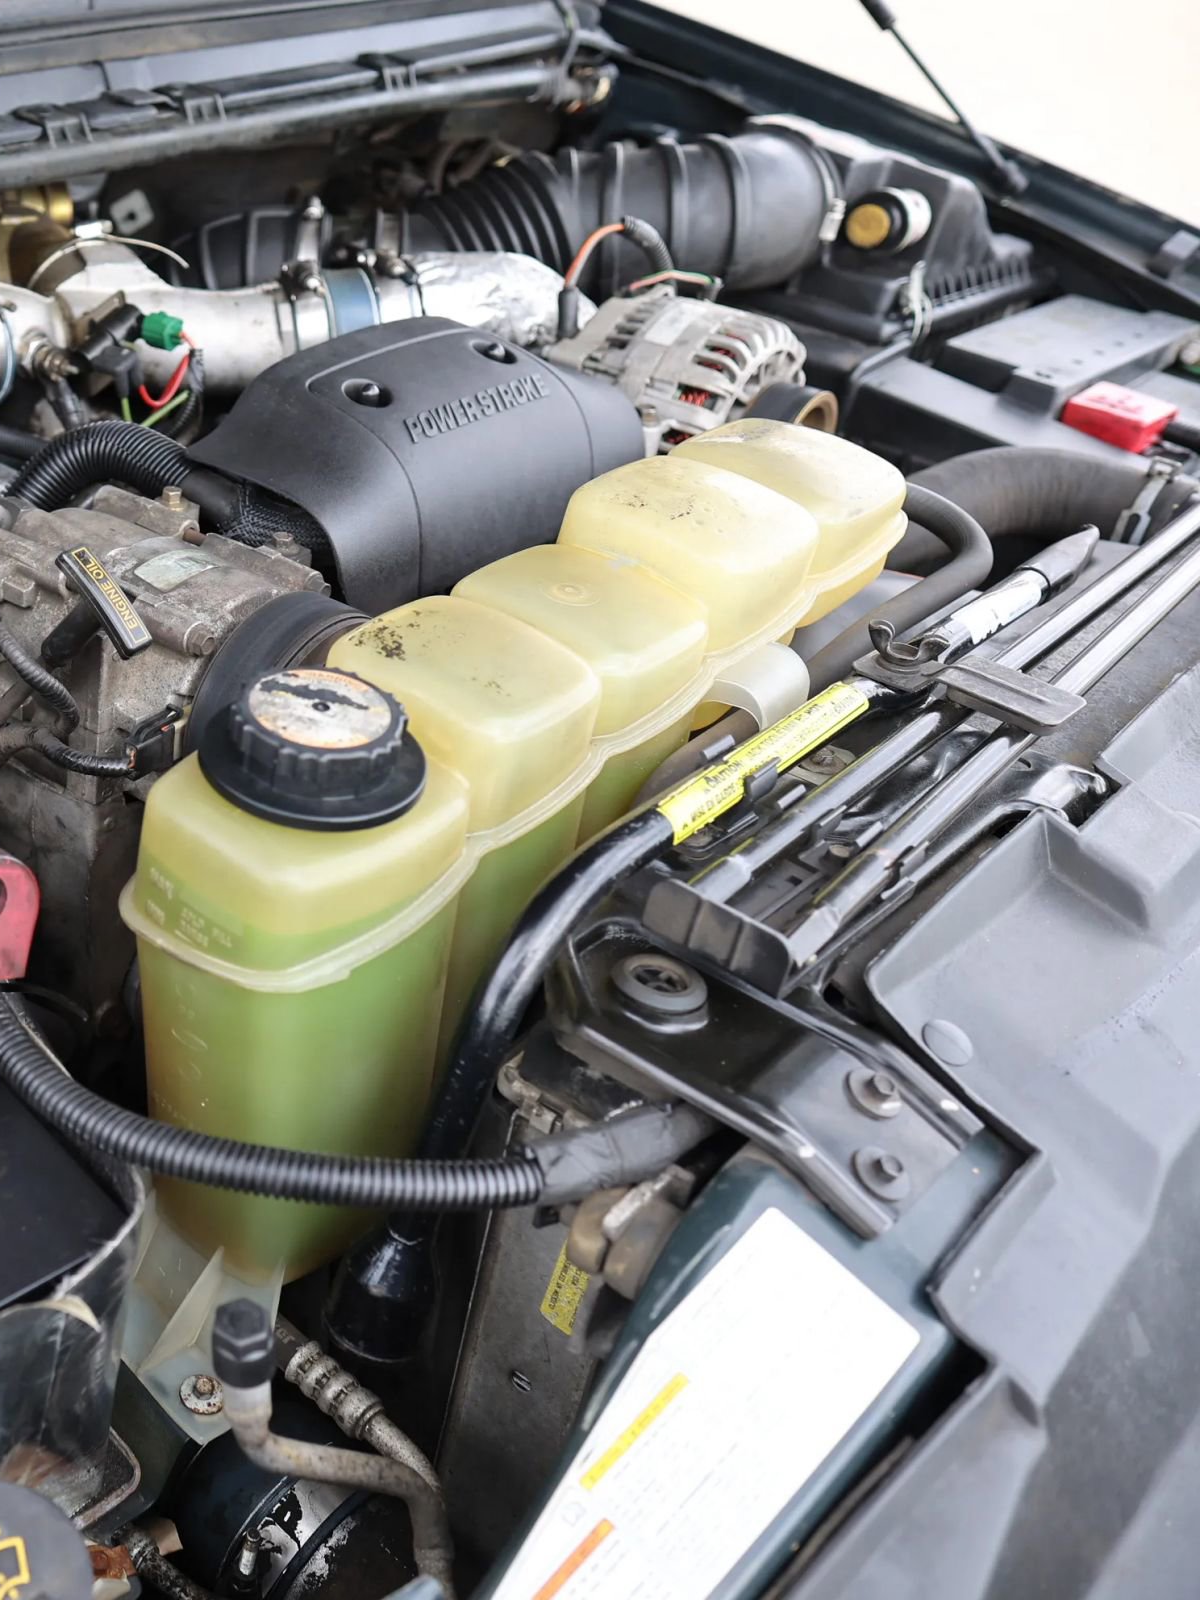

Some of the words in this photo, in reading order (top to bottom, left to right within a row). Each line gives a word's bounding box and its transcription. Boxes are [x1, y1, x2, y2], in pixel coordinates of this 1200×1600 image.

[403, 397, 480, 444] POWER
[475, 374, 550, 417] STROKE
[85, 560, 106, 580] OIL
[100, 581, 138, 629] ENGINE
